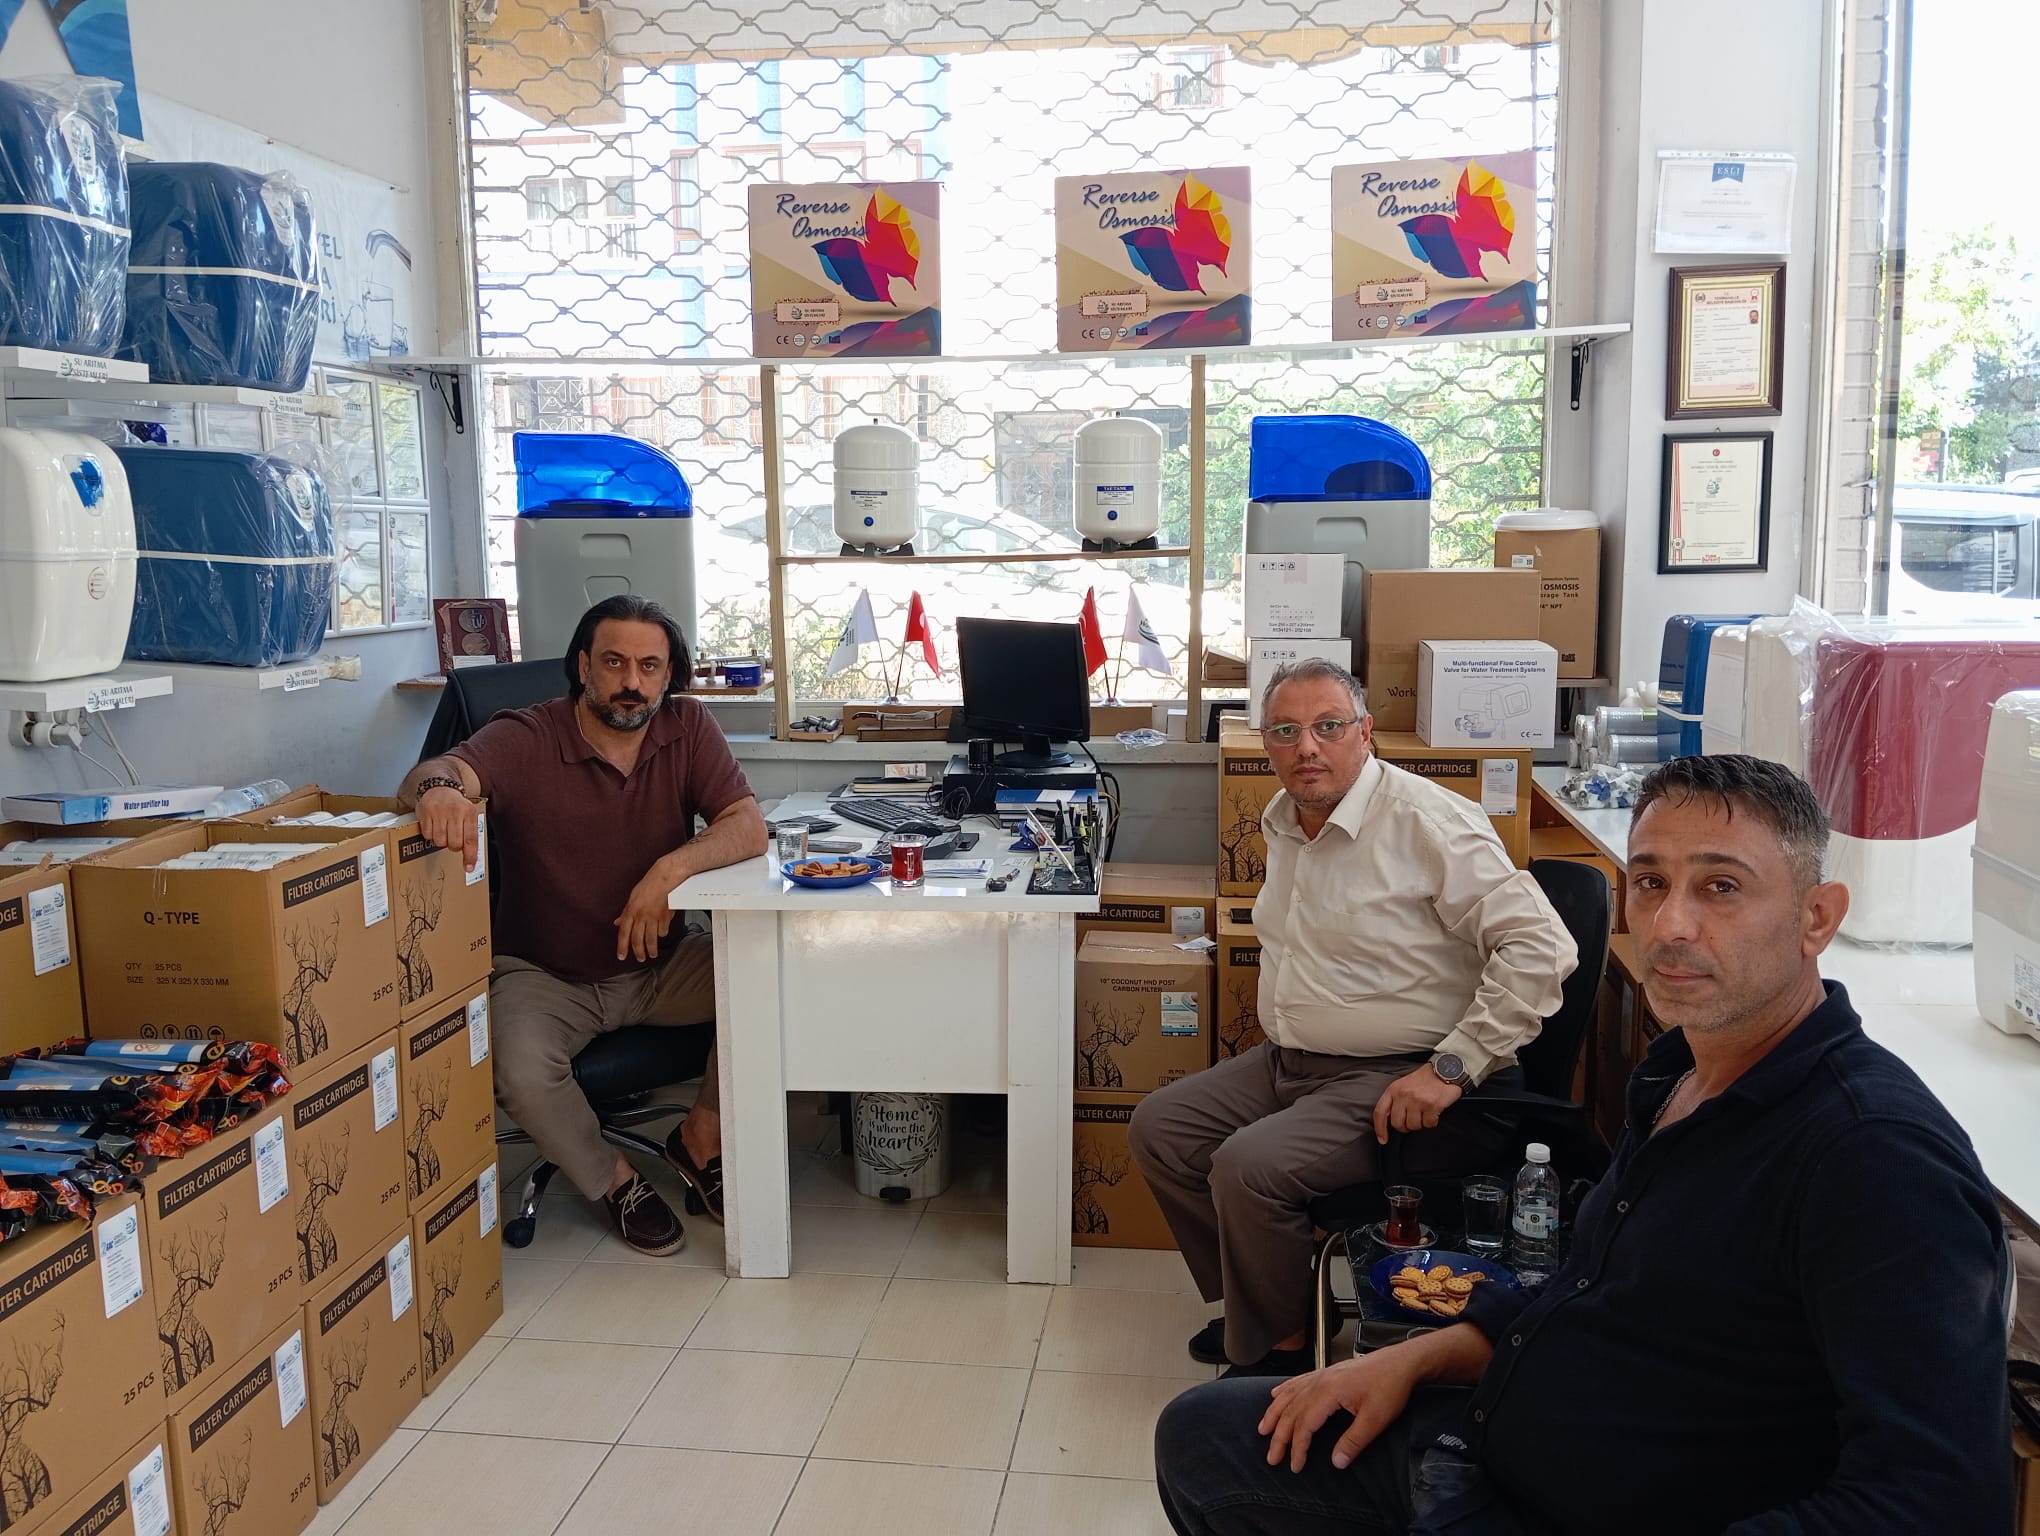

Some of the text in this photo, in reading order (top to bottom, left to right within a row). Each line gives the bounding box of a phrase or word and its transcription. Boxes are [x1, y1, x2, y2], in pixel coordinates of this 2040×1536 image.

[1361, 172, 1441, 197] Reverse
[776, 193, 850, 218] Reverse
[1082, 184, 1159, 209] Reverse
[1377, 195, 1458, 217] Osmosis
[792, 216, 867, 238] Osmosis
[1099, 206, 1178, 229] Osmosis
[1387, 686, 1417, 698] Work
[1230, 763, 1259, 772] FILTER
[1417, 764, 1472, 774] CARTRIDGE
[124, 801, 140, 811] Water
[161, 799, 170, 809] tap
[402, 841, 425, 858] FILTER
[287, 864, 355, 901] FILTER CARTRIDGE
[164, 912, 200, 924] TYPE
[1109, 909, 1160, 919] CARTRIDGE
[470, 936, 487, 952] 25 PCS
[125, 962, 141, 971] QTY
[166, 964, 182, 972] PCS
[1236, 952, 1260, 963] FILTE
[127, 976, 144, 984] SIZE
[216, 978, 229, 986] MM
[372, 982, 393, 1002] 25 PCS
[413, 1032, 432, 1054] FILTER
[433, 1014, 464, 1041] CARTRIDGE
[298, 1073, 366, 1121] FILTER CARTRIDGE
[870, 1104, 919, 1122] Home
[1074, 1109, 1103, 1119] FILTER
[876, 1122, 907, 1134] where
[909, 1122, 926, 1134] the
[868, 1130, 913, 1152] heart
[164, 1183, 196, 1209] FILTER
[196, 1148, 247, 1189] CARTRIDGE
[381, 1182, 400, 1204] 25 PCS
[428, 1213, 446, 1236] FILTER
[446, 1187, 477, 1221] CARTRIDGE
[24, 1244, 88, 1297] CARTRIDGE
[268, 1268, 293, 1294] 25 PCS
[324, 1303, 346, 1328] FILTER
[346, 1266, 383, 1307] CARTRIDGE
[400, 1364, 417, 1389] 25 PCS
[124, 1372, 155, 1406] 25 PCS
[194, 1410, 223, 1442] FILTER
[223, 1368, 269, 1415] CARTRIDGE
[290, 1473, 311, 1503] 25 PCS
[74, 1495, 121, 1536] RTRIDGE
